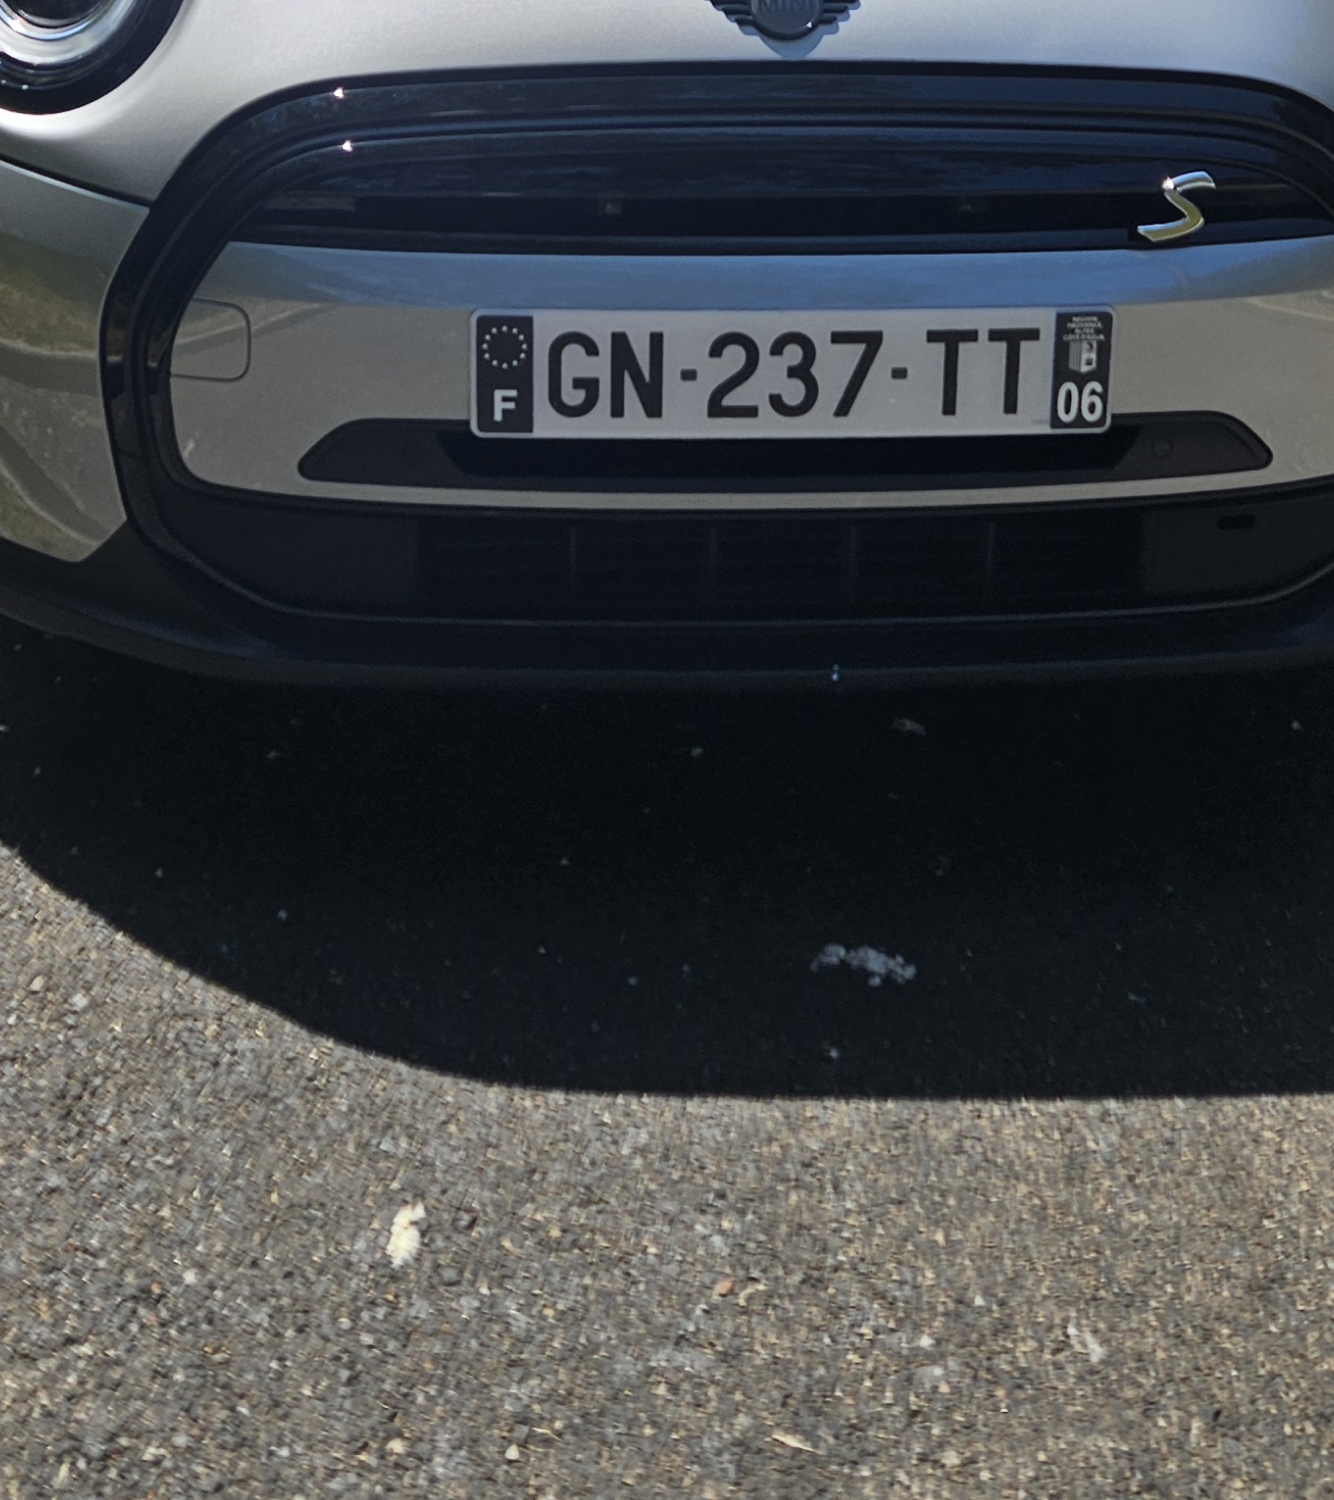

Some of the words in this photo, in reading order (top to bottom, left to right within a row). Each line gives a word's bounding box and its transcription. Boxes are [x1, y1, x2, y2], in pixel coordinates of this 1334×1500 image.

[1136, 170, 1216, 242] S
[547, 327, 1041, 419] GN-237-TT
[1056, 380, 1104, 423] 06
[493, 389, 518, 422] F
